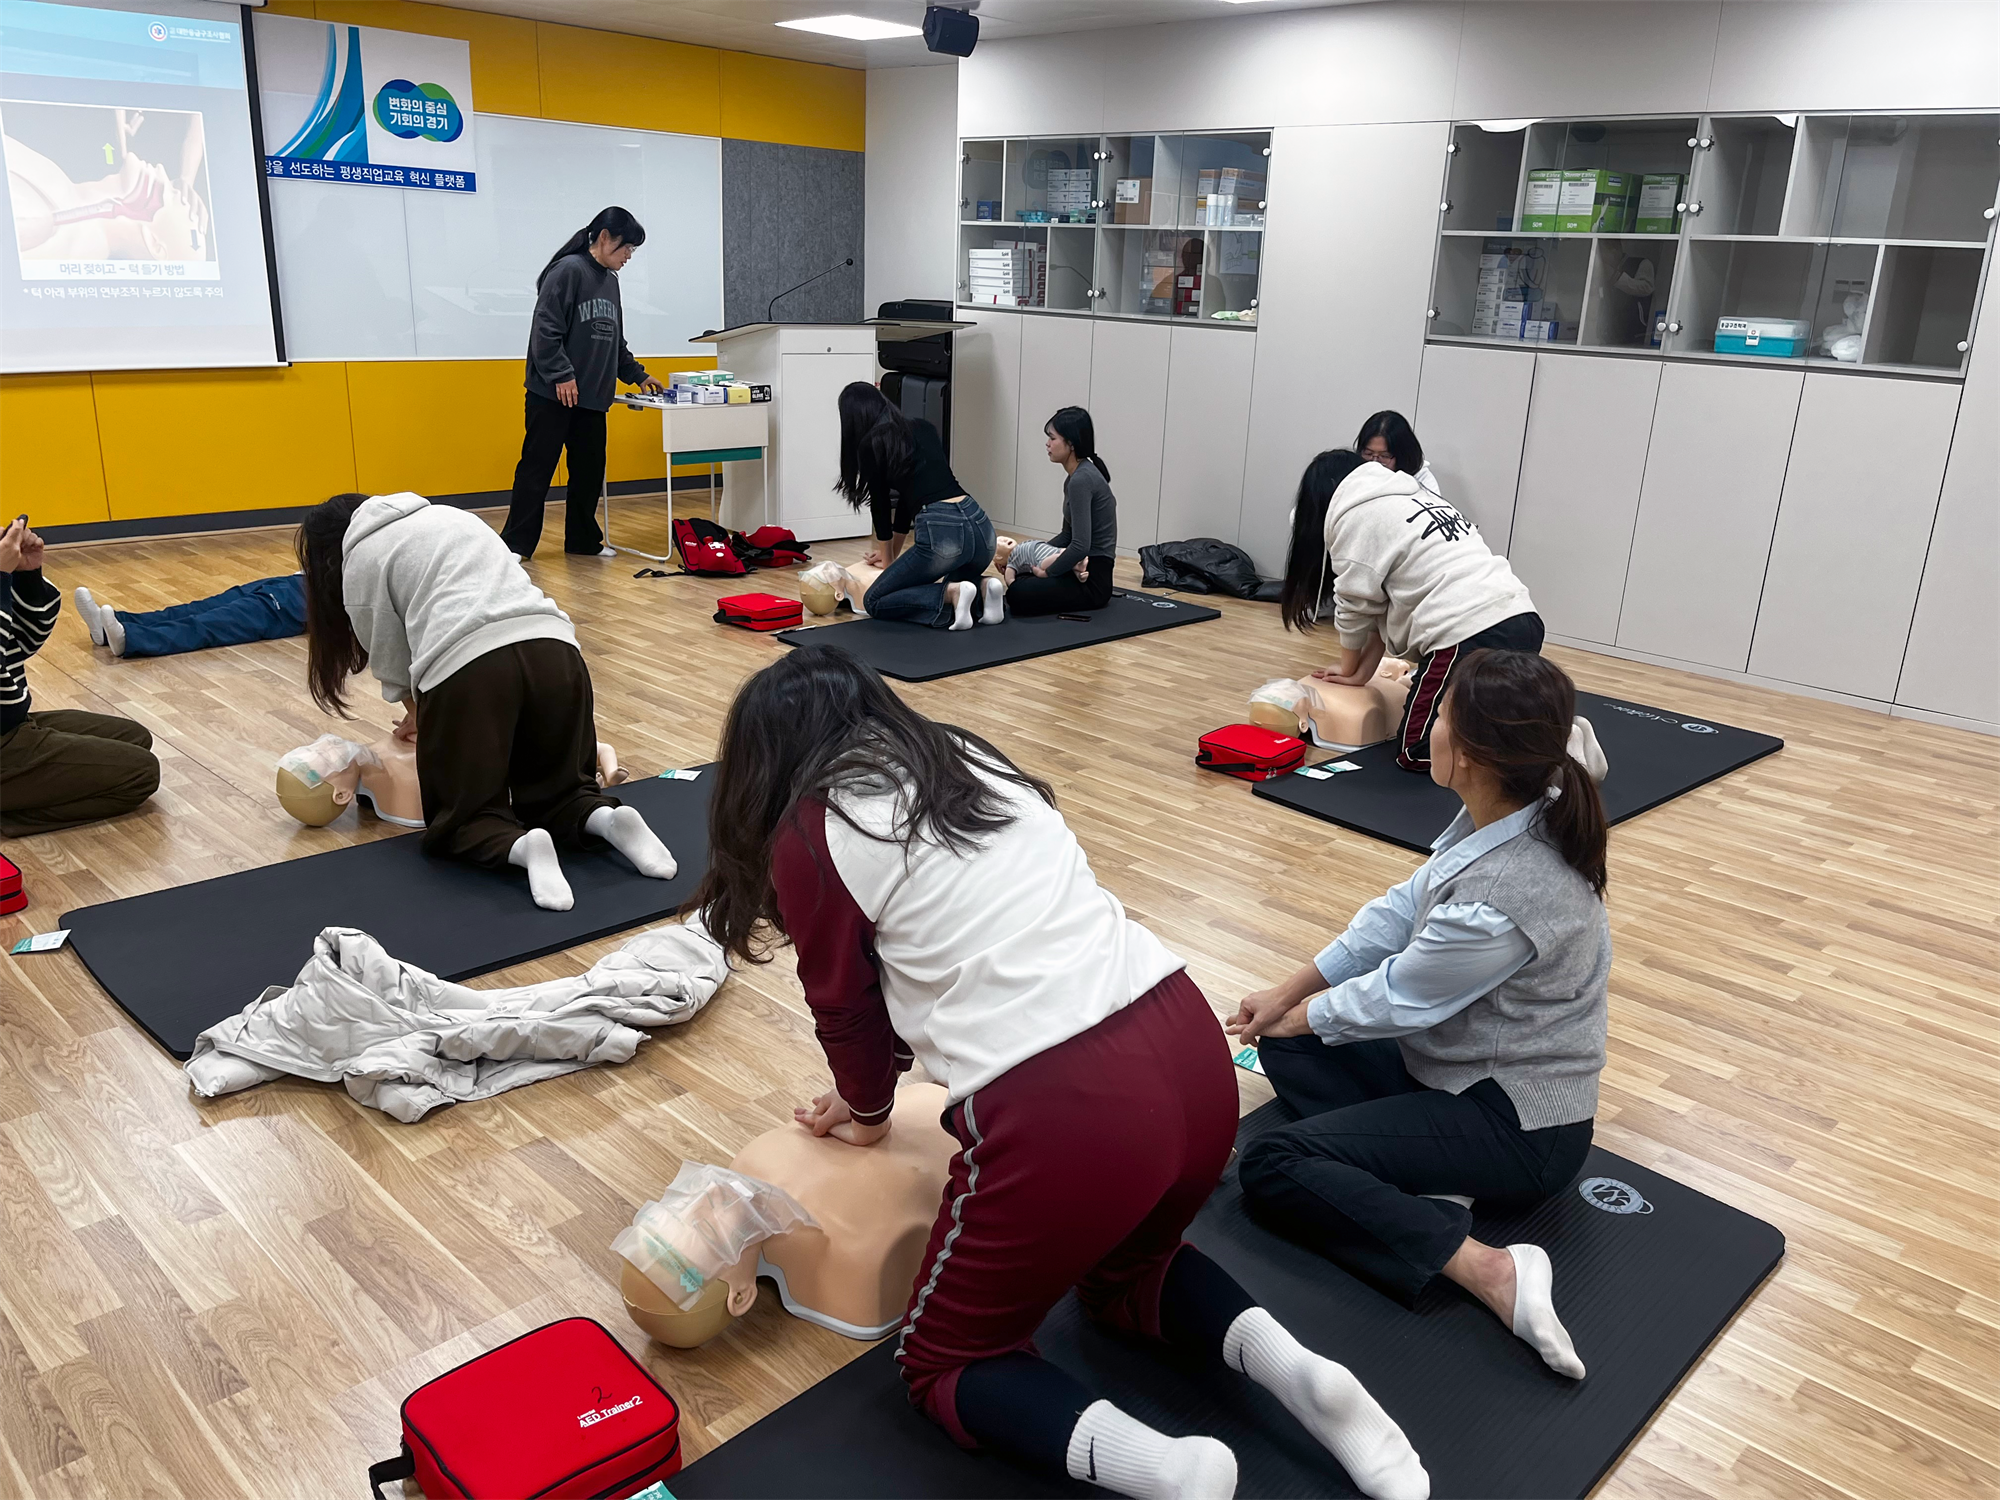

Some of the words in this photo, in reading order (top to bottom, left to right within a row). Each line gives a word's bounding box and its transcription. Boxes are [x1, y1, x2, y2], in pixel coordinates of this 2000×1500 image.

[389, 97, 423, 113] 변화의
[425, 101, 447, 116] 중심
[390, 112, 424, 127] 기회의
[426, 115, 448, 130] 경기
[289, 161, 335, 178] 선도하는
[340, 165, 404, 184] 평생직업교육
[409, 172, 430, 186] 혁신
[434, 173, 466, 188] 플랫폼
[59, 263, 82, 275] 머리
[84, 263, 117, 275] 젖히고
[128, 264, 139, 275] 턱
[141, 264, 163, 276] 들기
[164, 264, 185, 276] 방법
[31, 287, 42, 299] 턱
[44, 287, 65, 299] 아래
[67, 287, 98, 299] 부위의
[99, 287, 140, 298] 연부조직
[142, 287, 171, 298] 누르지
[173, 287, 203, 298] 않도록
[204, 287, 224, 299] 주의
[591, 1386, 612, 1404] 2
[579, 1413, 601, 1428] AED
